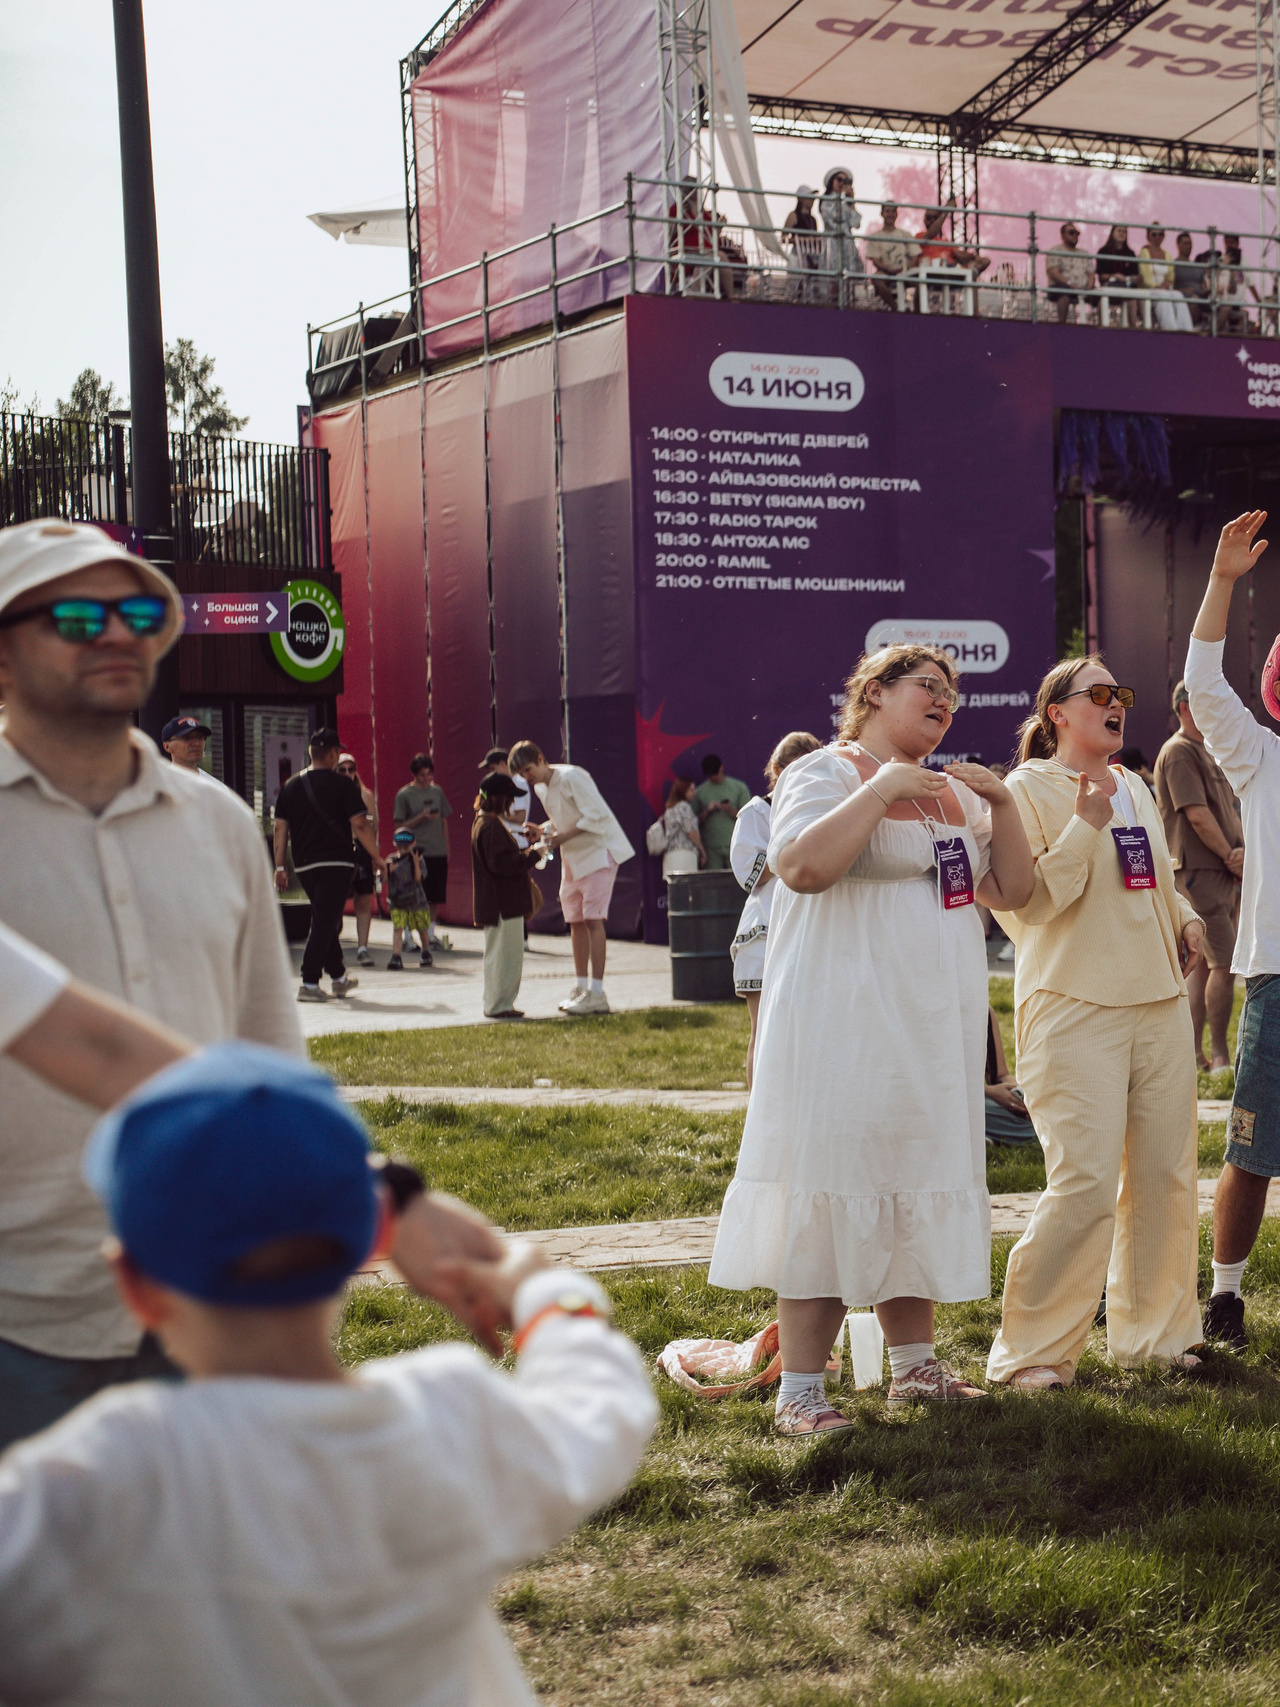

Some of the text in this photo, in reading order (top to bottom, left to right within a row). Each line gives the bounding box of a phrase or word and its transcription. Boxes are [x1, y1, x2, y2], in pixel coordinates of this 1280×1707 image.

[723, 376, 852, 400] 14 ИЮНЯ
[651, 427, 868, 449] 14:00 ОТКРЫТИЕ ДВЕРЕЙ
[652, 448, 801, 467] 14:30 НАТАЛИКА
[653, 469, 921, 492] 15:30 АЙВАЗОВСКИЙ ОРКЕСТРА
[653, 490, 865, 511] 16:30 BETSY (SIGMA BOY)
[654, 511, 698, 525] 17:30
[709, 513, 761, 528] RADIO
[654, 532, 701, 546] 18:30
[711, 534, 780, 549] АНТОХА
[655, 553, 771, 569] 20:00 RAMIL
[656, 574, 905, 592] 21:00 ОТПЕТЫЕ МОШЕННИКИ
[207, 602, 259, 613] Большая
[224, 615, 259, 625] сцена
[295, 630, 325, 646] кофе
[968, 691, 1030, 708] ДВЕРЕЙ
